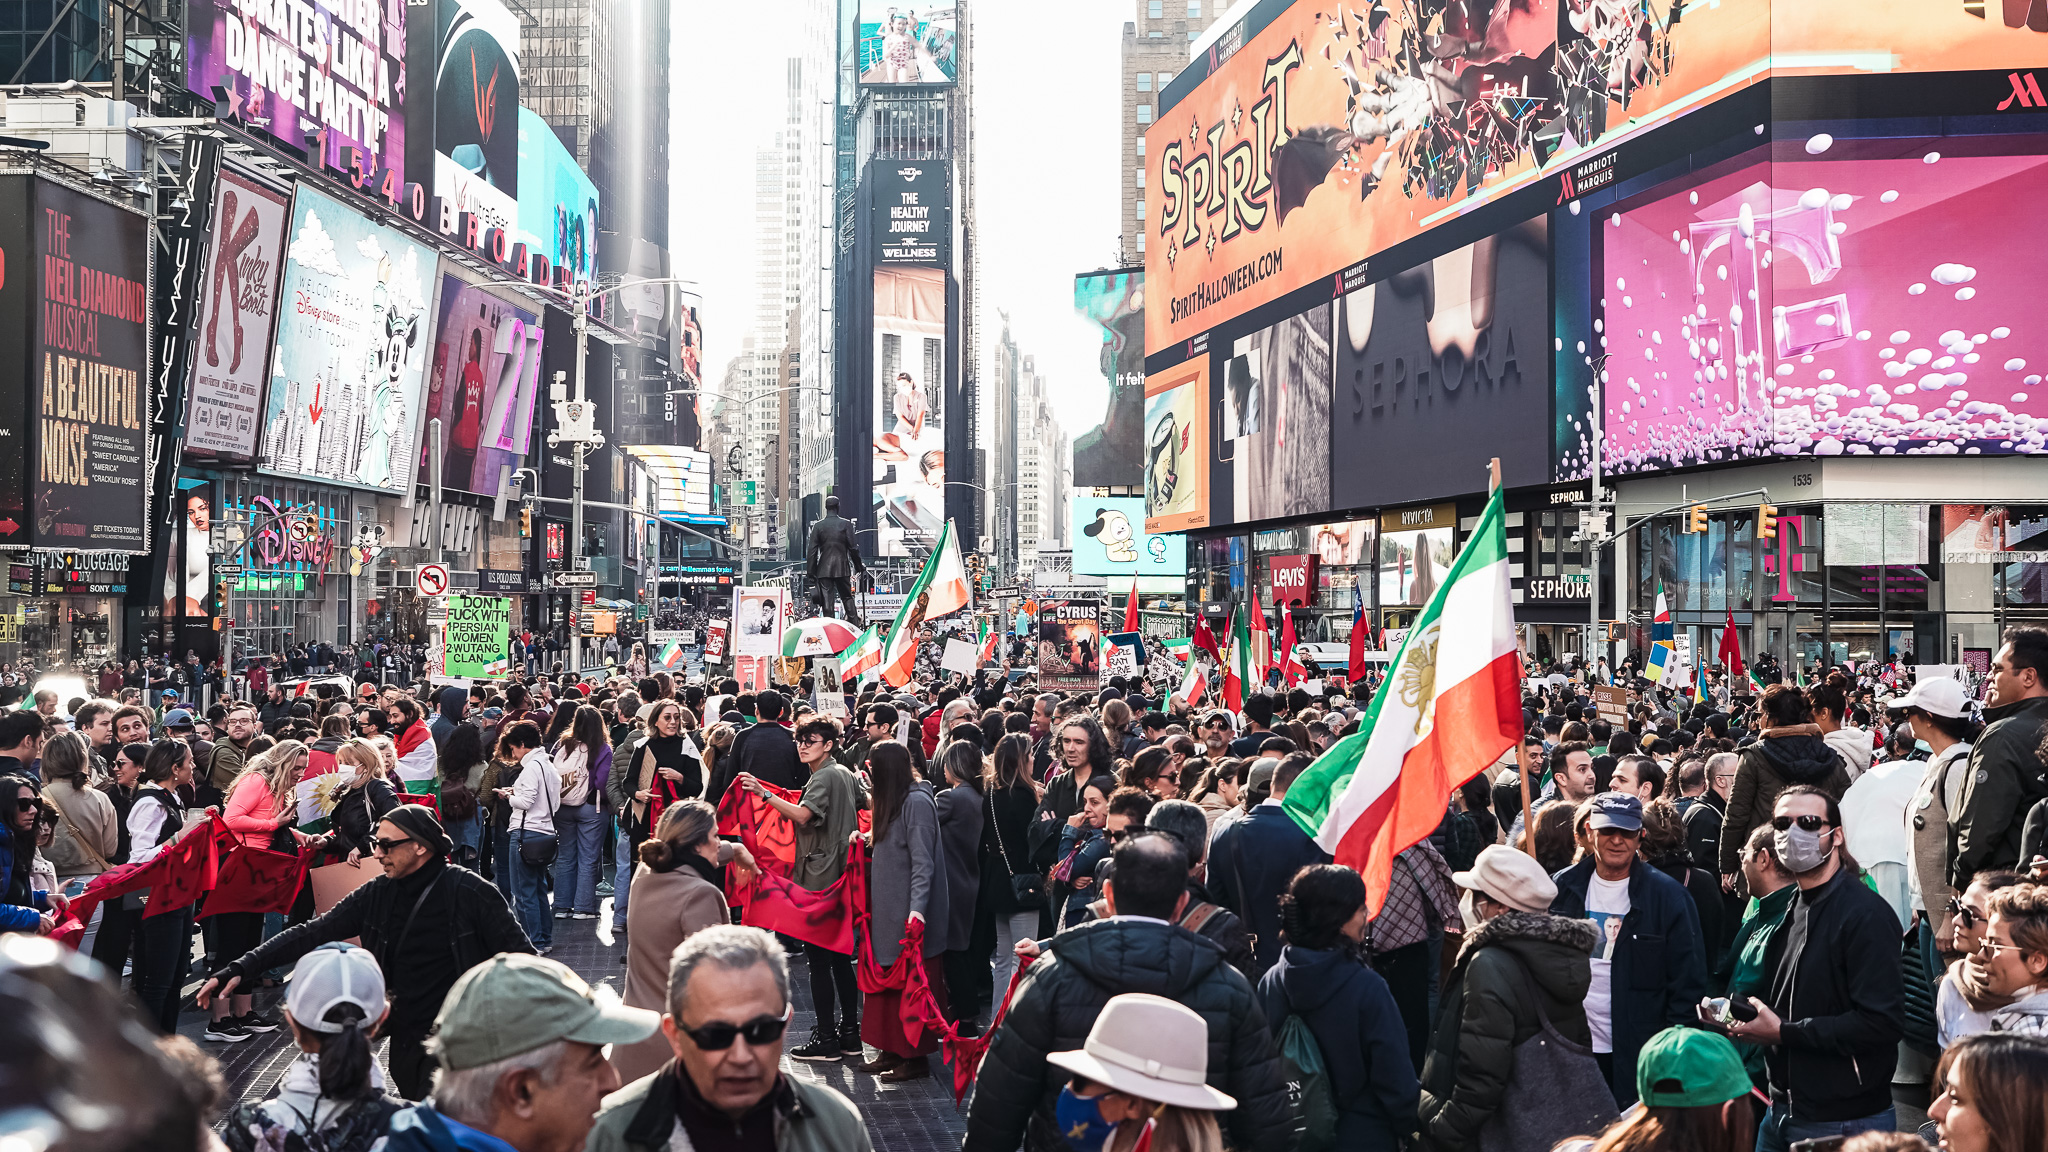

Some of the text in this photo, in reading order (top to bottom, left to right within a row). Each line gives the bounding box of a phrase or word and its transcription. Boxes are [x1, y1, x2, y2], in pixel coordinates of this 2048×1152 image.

[1219, 21, 1243, 48] MARRIOTT
[1219, 38, 1242, 63] MARQUIS
[225, 11, 305, 110] DANCE
[331, 22, 375, 97] LIKE
[378, 58, 390, 108] A
[1161, 37, 1300, 250] SPIRIT
[1577, 152, 1618, 179] MARRIOTT
[1577, 169, 1614, 193] MARQUIS
[901, 192, 918, 204] THE
[469, 194, 509, 234] UltraGear
[891, 206, 929, 219] HEALTHY
[45, 207, 72, 259] THE
[889, 220, 930, 232] JOURNEY
[882, 248, 937, 258] WELLNESS
[1344, 261, 1369, 280] MARRIOTT
[45, 254, 145, 324] NEIL DIAMOND
[1344, 275, 1366, 290] MARQUIS
[238, 285, 269, 316] Boots
[299, 275, 364, 312] WELCOME BACK
[322, 308, 340, 325] store
[44, 300, 102, 357] MUSICAL
[299, 322, 322, 341] VISIT
[1352, 325, 1521, 415] SEPHORA
[1116, 371, 1145, 386] It felt
[42, 350, 140, 430] A BEAUTIFUL
[92, 433, 115, 443] FEATURING
[114, 436, 122, 444] ALL
[40, 418, 90, 487] NOISE
[113, 444, 135, 452] INCLUDING
[1792, 473, 1812, 487] 1535
[1550, 489, 1585, 504] SEPHORA
[1401, 508, 1433, 526] INVICTA
[93, 524, 140, 534] GET TICKETS TODAY!
[26, 552, 130, 572] GIFTS LUGGAGE
[78, 571, 91, 582] NY
[496, 573, 509, 584] POLO
[1567, 575, 1574, 583] W
[47, 583, 64, 592] Nikon
[66, 584, 86, 593] Canon
[90, 584, 110, 593] SONY
[1530, 580, 1592, 599] SEPHORA
[463, 596, 502, 609] DONT
[447, 608, 479, 621] FUCK
[481, 609, 509, 622] WITH
[1056, 606, 1097, 619] CYRUS
[1146, 616, 1181, 624] DISCOVER
[452, 632, 494, 643] WOMEN
[453, 653, 484, 663] CLAN
[1597, 692, 1612, 702] RISE
